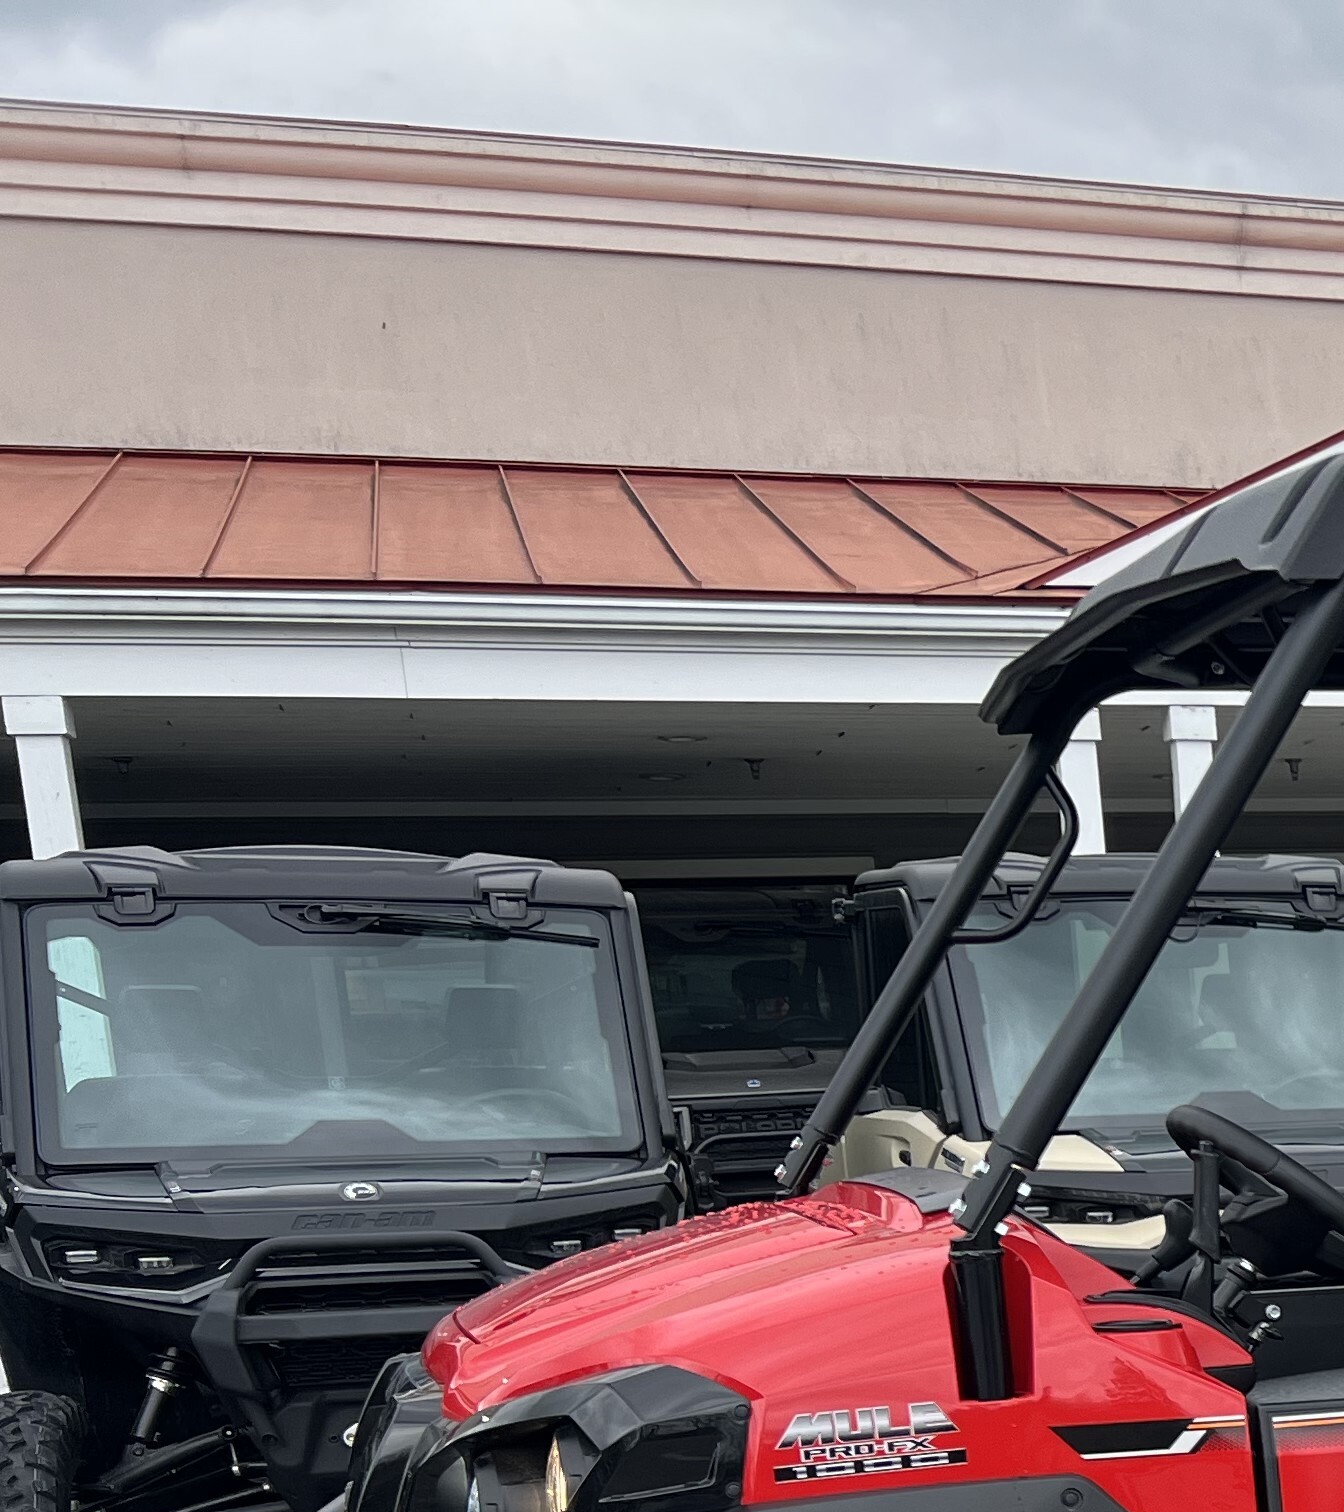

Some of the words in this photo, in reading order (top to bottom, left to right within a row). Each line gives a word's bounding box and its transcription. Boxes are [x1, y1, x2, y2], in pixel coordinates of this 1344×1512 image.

[291, 1210, 437, 1231] can-am
[776, 1402, 959, 1449] MULE
[801, 1436, 936, 1463] PRO-FX
[793, 1452, 950, 1479] 1000
